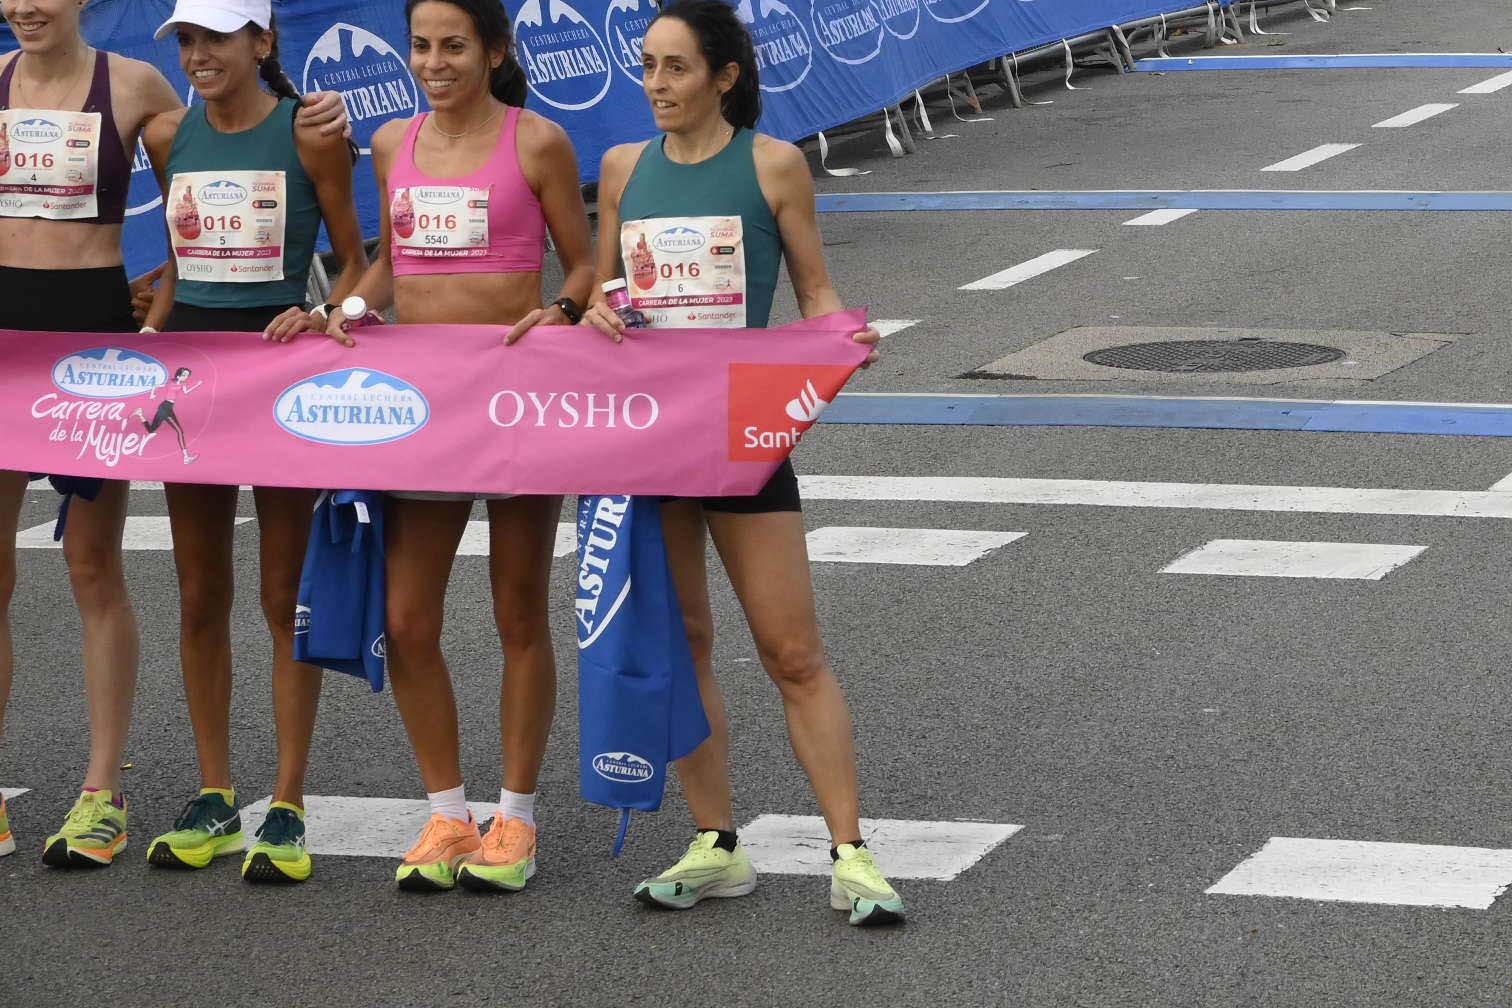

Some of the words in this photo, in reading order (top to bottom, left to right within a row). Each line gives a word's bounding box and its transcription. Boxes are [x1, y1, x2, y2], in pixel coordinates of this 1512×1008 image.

[521, 40, 607, 86] ASTURIANA
[325, 66, 360, 86] CENTRAL
[13, 128, 58, 137] ASTURIANA
[15, 153, 54, 167] 016
[202, 191, 244, 200] ASTURIANA
[418, 189, 461, 198] ASTURIANA
[204, 216, 241, 230] 016
[419, 214, 456, 229] 016
[220, 236, 226, 245] 5
[425, 235, 448, 244] 5540
[657, 239, 700, 247] ASTURIANA
[186, 264, 212, 272] OYSHO
[660, 263, 700, 278] 016
[678, 284, 683, 292] 6
[697, 312, 736, 321] Santander
[60, 363, 157, 388] ASTURIANA
[32, 392, 124, 421] Carrera
[286, 398, 416, 426] ASTURIANA
[489, 390, 659, 430] OYSHO
[49, 424, 67, 443] de
[70, 425, 83, 443] la
[76, 420, 155, 466] Mujer
[597, 760, 649, 779] ASTURIANA
